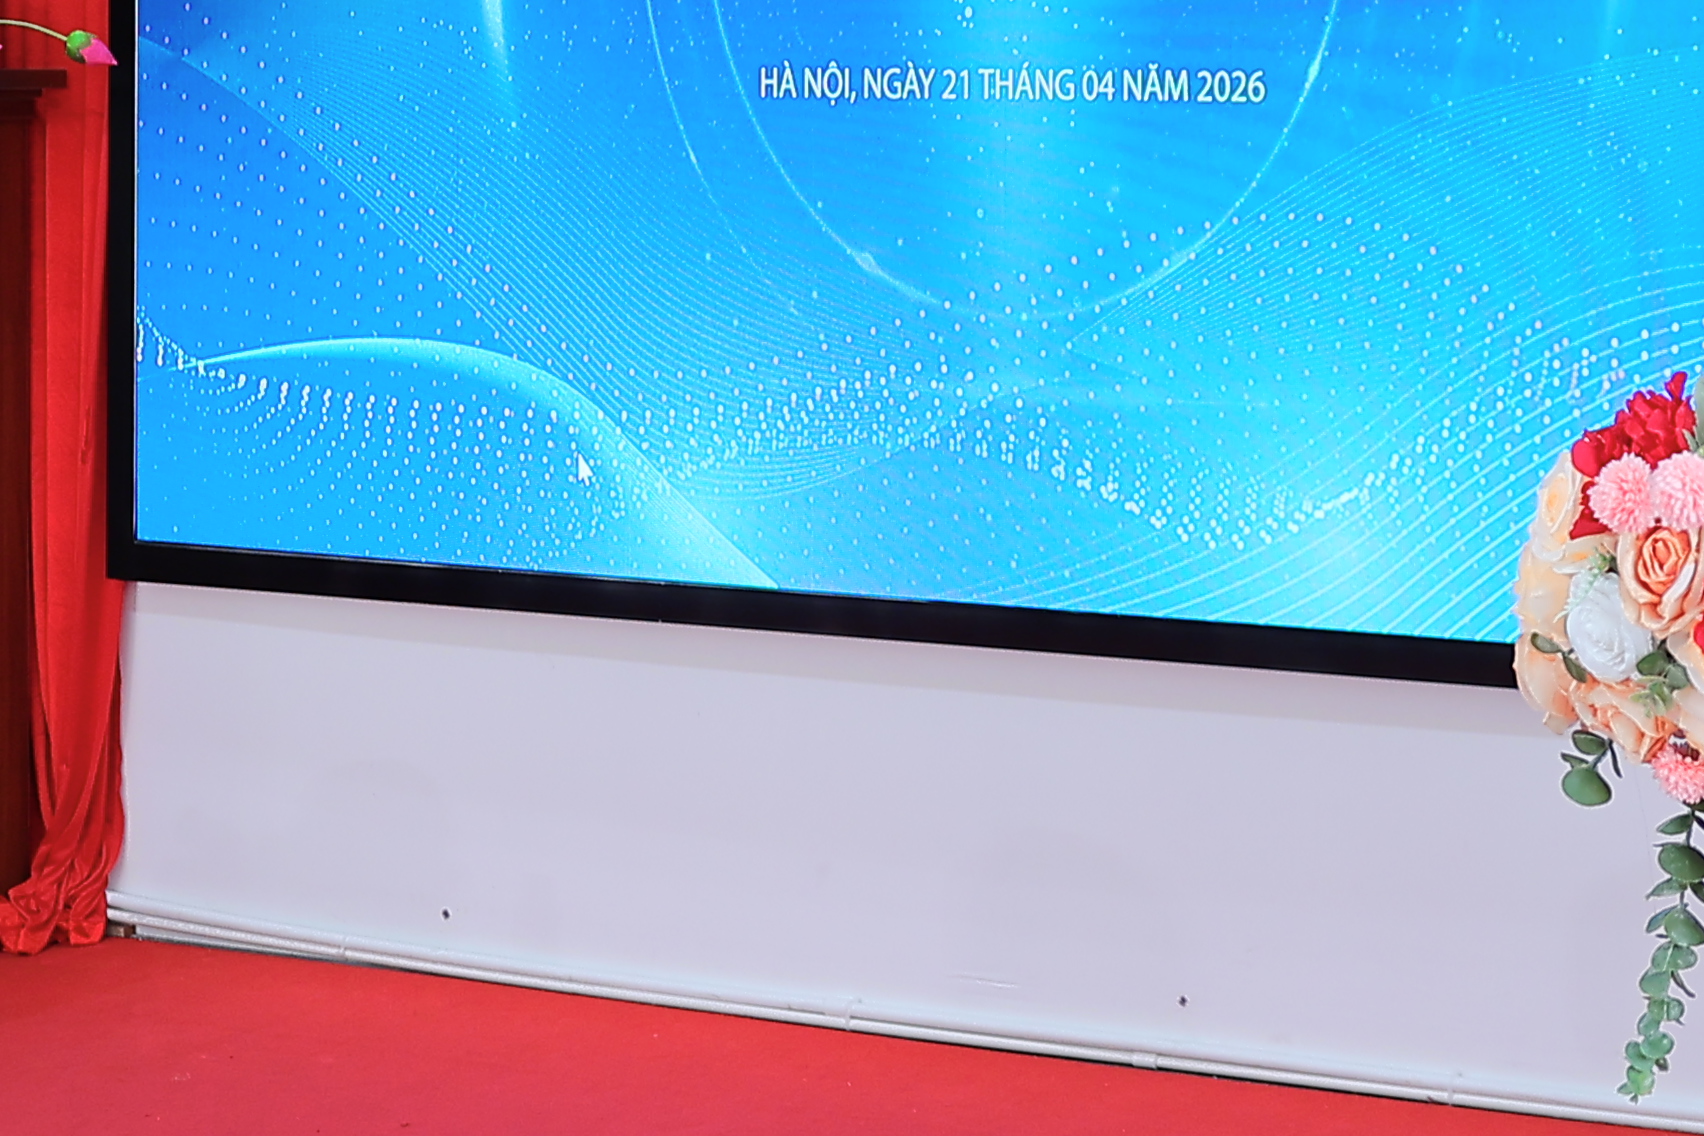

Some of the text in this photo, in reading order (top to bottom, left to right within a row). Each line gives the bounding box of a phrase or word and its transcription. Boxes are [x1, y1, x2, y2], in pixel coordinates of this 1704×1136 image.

[760, 60, 1266, 106] HÀ NỘI, NGÀY 21 THÁNG 04 NĂM 2026
